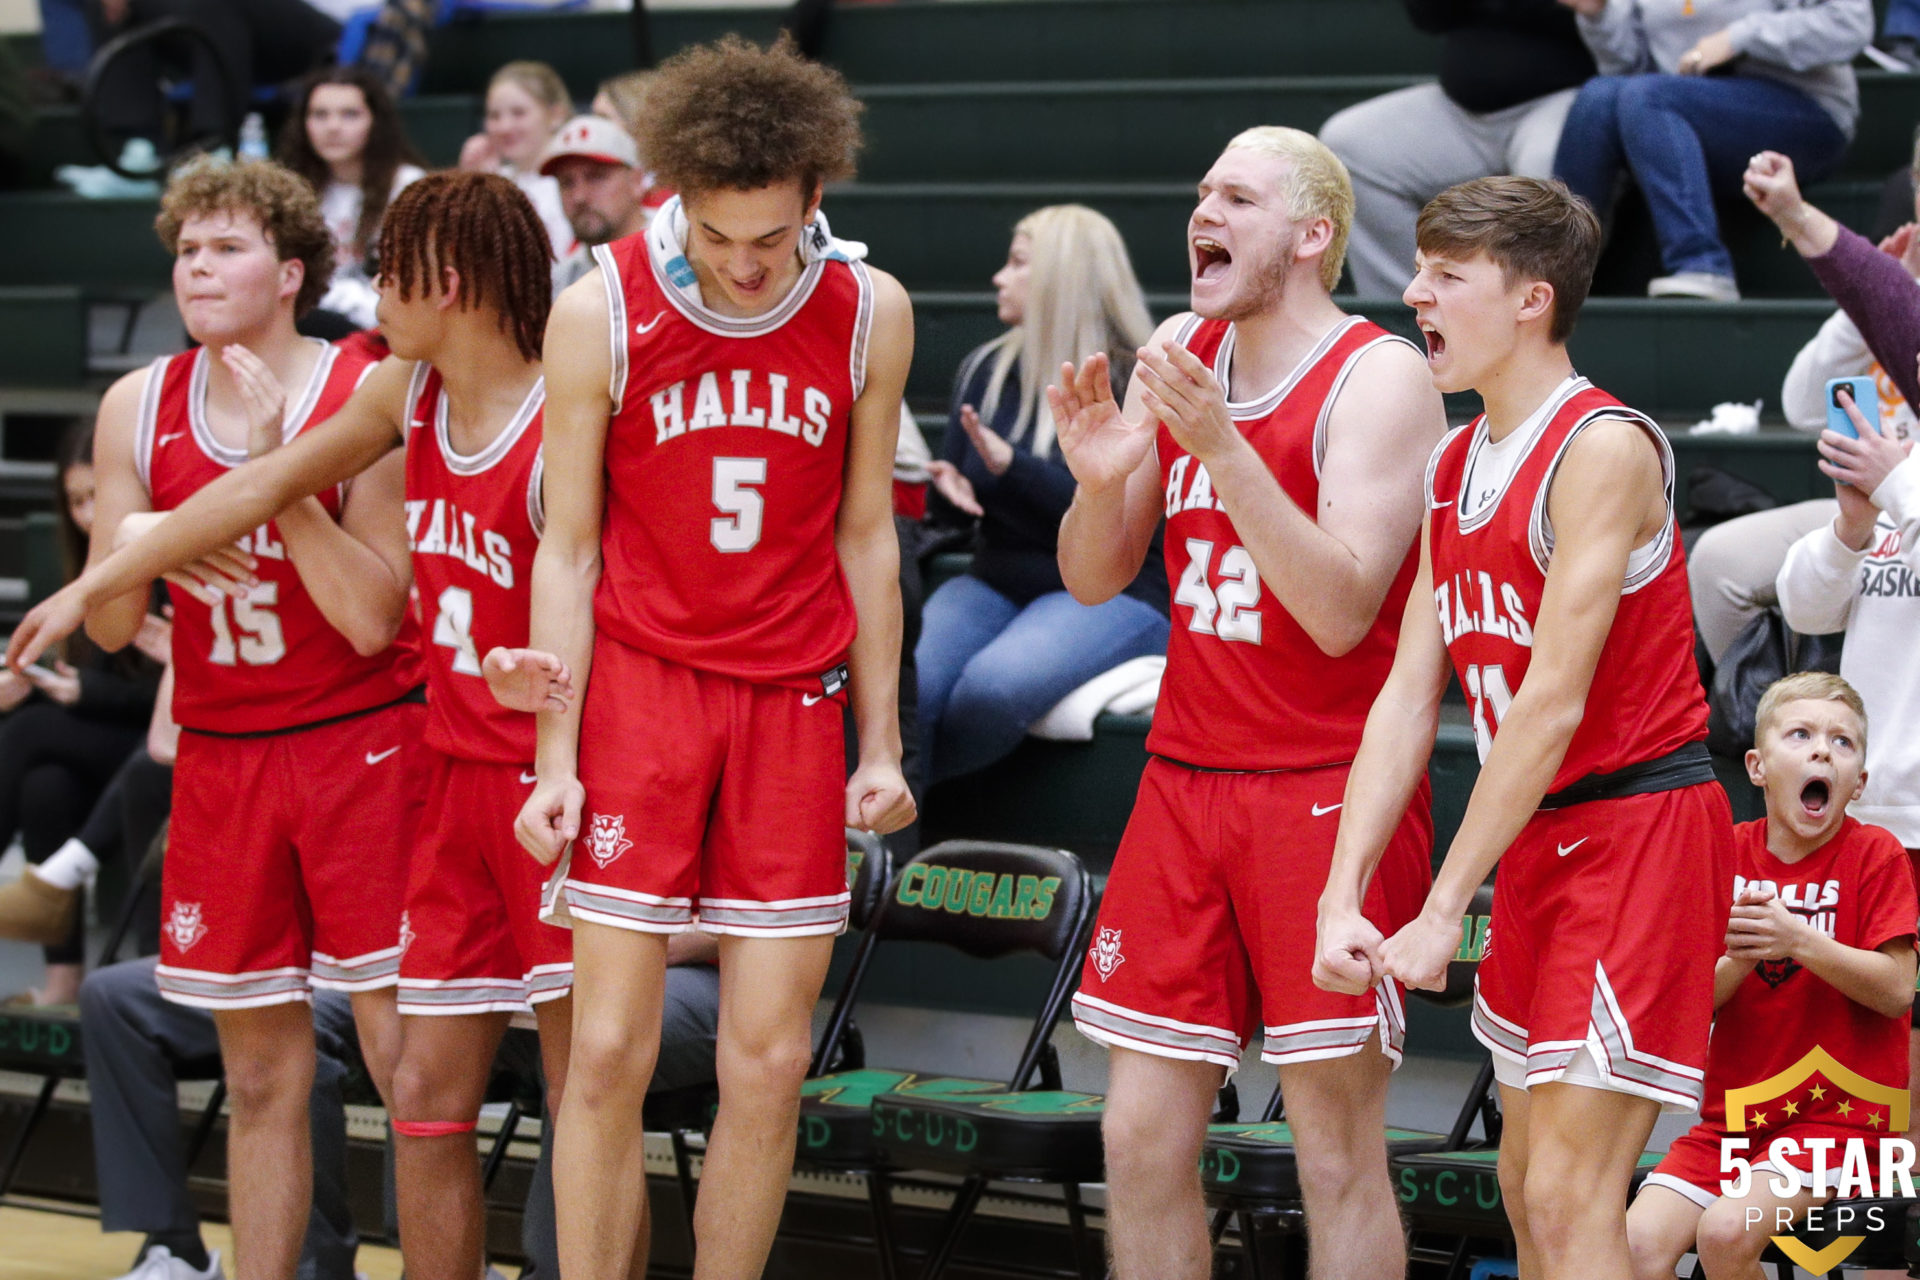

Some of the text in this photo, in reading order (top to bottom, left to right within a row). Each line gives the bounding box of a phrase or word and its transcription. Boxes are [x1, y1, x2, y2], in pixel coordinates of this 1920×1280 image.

[650, 369, 832, 448] HALLS
[710, 456, 767, 554] 5
[205, 581, 286, 667] 15
[432, 585, 482, 677] 4
[1174, 537, 1262, 646] 42
[896, 862, 1061, 921] COUGARS
